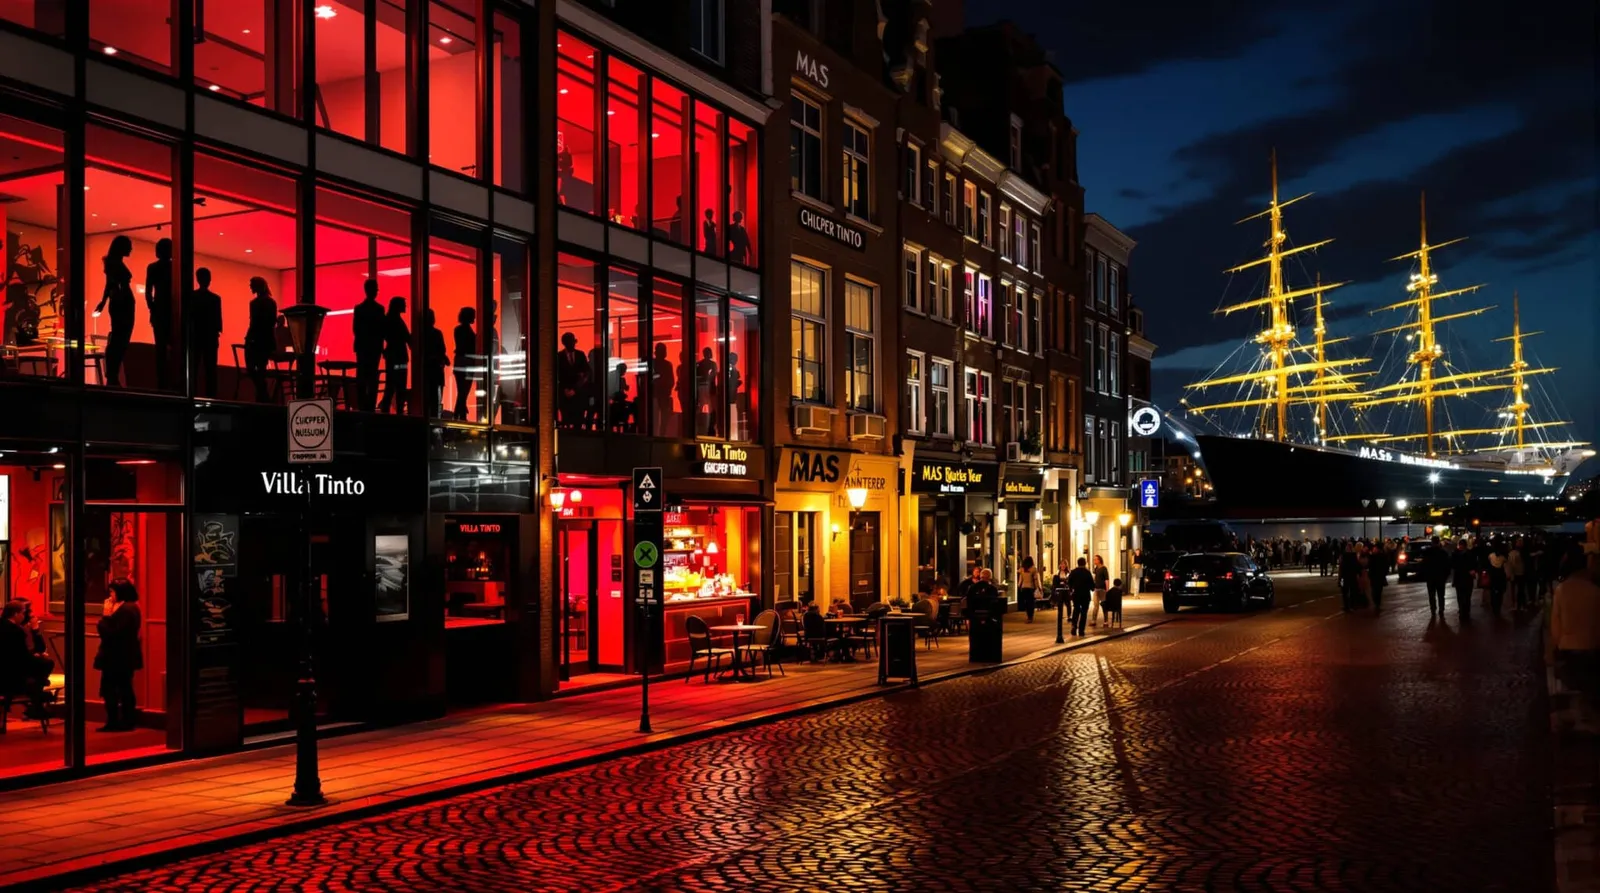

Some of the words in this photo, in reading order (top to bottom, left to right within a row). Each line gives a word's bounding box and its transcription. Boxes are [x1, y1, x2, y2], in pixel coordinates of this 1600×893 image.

[796, 50, 829, 88] MAS
[836, 223, 862, 248] TINTO
[700, 443, 721, 460] Villa
[789, 452, 839, 483] MAS
[923, 465, 943, 481] MAS
[315, 474, 365, 495] Tinto
[460, 524, 479, 533] VILLA
[480, 524, 501, 533] TINTO
